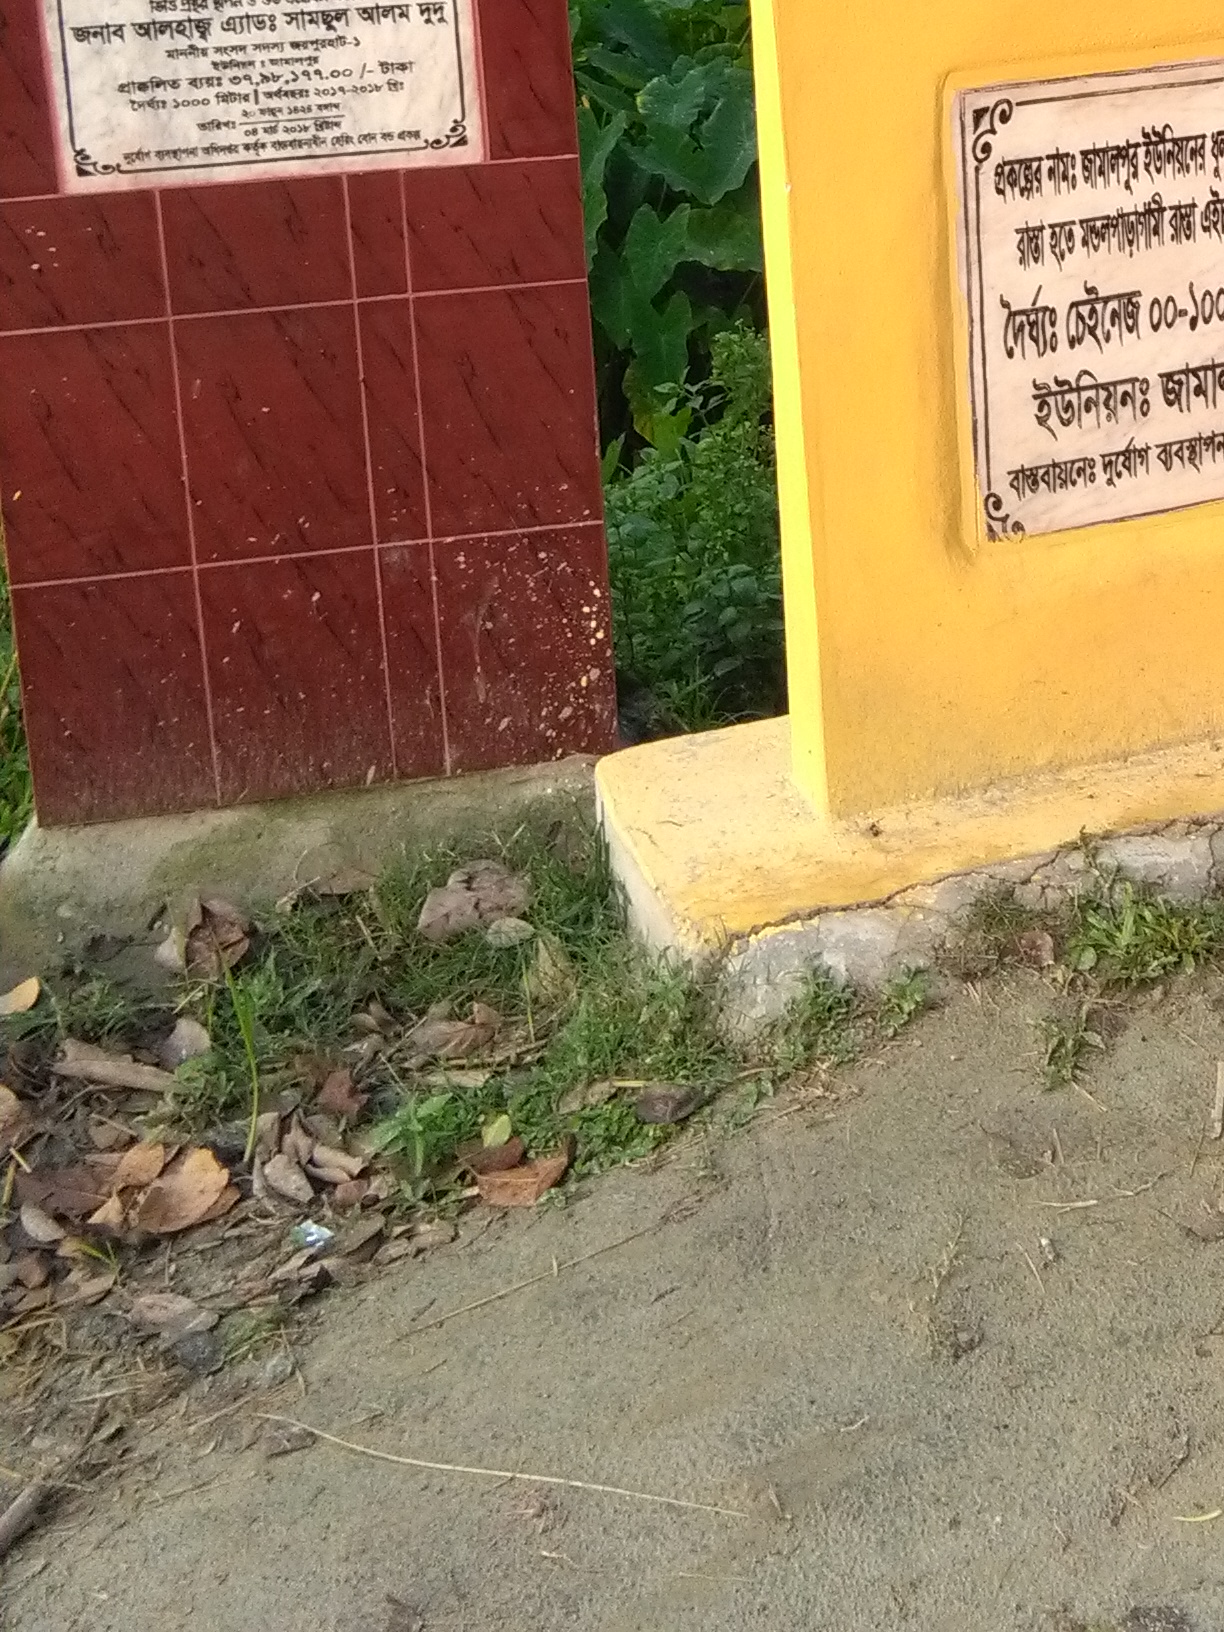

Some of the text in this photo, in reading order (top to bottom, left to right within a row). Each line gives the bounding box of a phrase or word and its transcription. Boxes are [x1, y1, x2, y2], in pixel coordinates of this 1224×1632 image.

[70, 22, 126, 45] জনাব
[355, 3, 412, 25] আলম
[173, 96, 211, 109] ১০০০
[1080, 138, 1142, 195] জামালপুর
[1048, 220, 1076, 272] হতে
